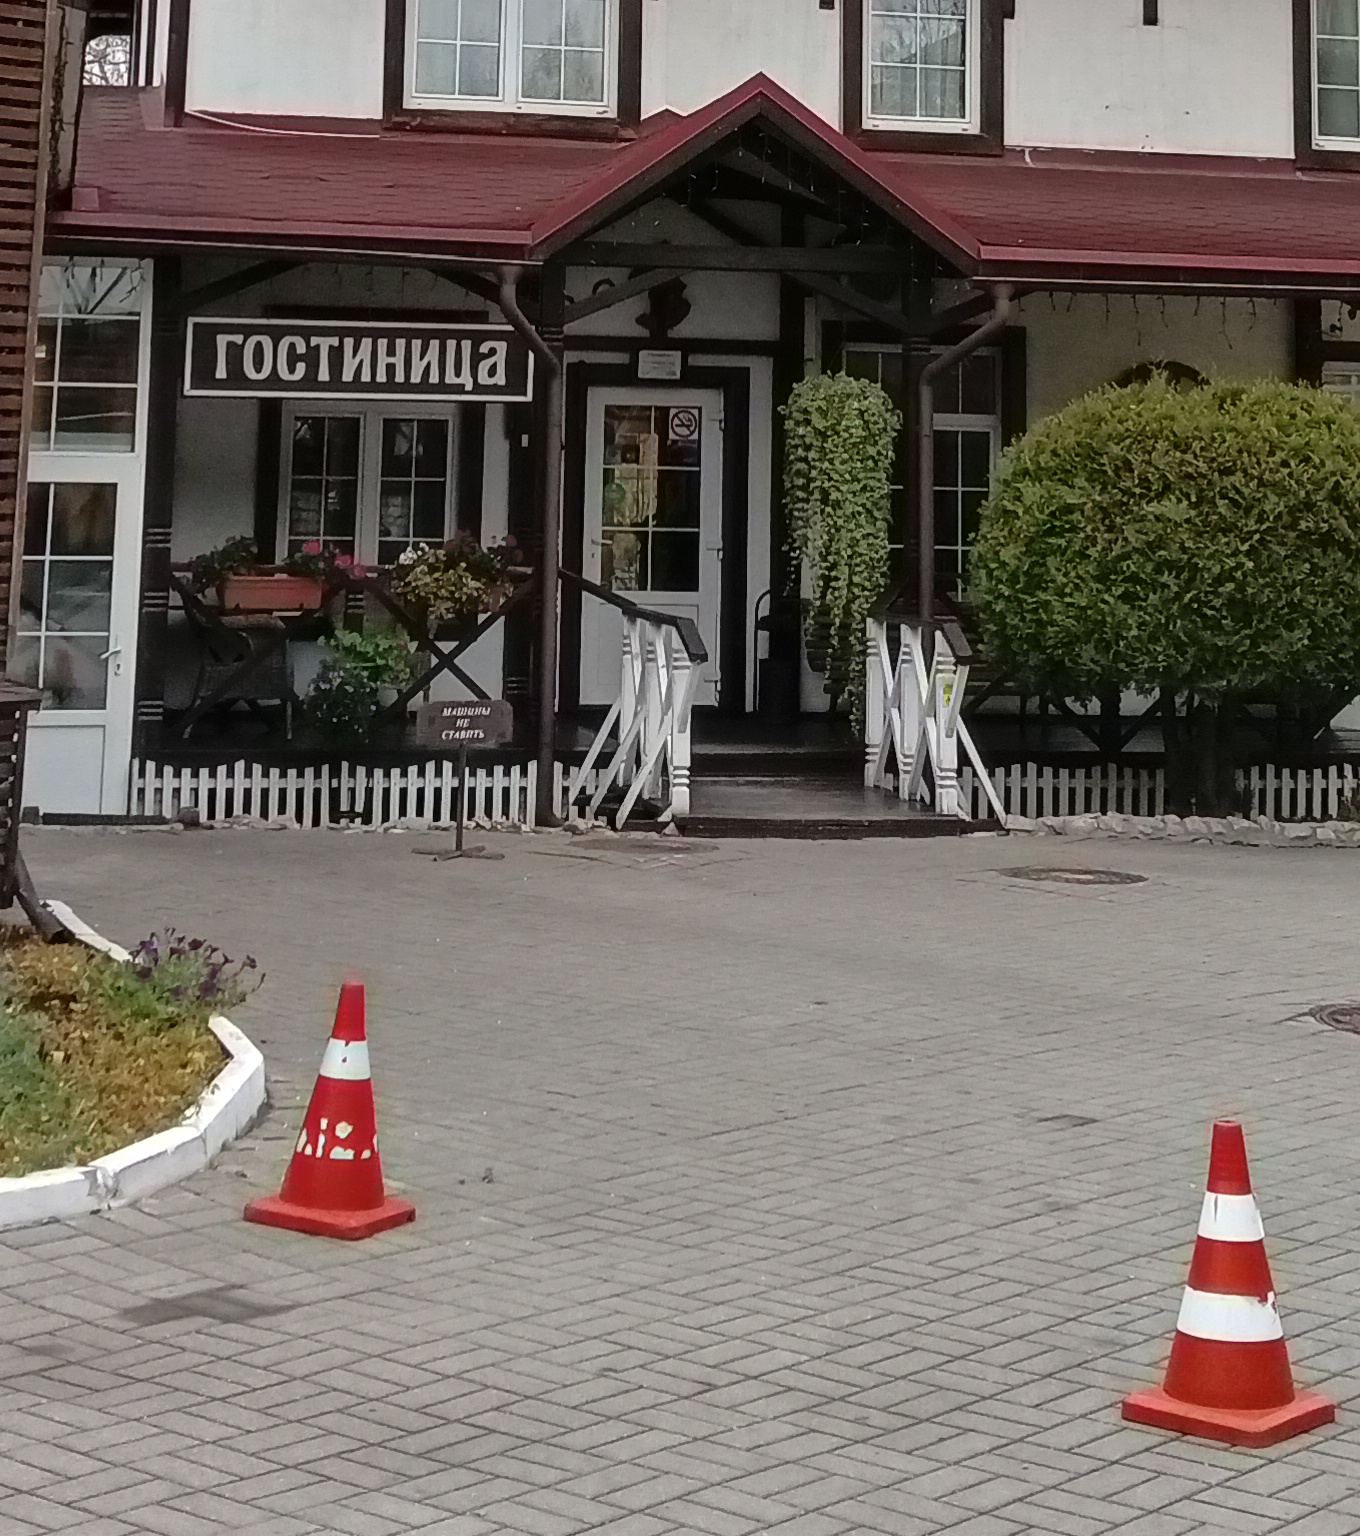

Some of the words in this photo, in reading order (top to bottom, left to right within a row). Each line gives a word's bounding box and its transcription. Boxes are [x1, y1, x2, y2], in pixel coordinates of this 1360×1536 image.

[215, 334, 507, 391] ГОСТИНИЦА
[442, 706, 491, 716] МАШИНЫ
[455, 718, 470, 728] НЕ
[441, 729, 485, 740] СТАВИТЬ
